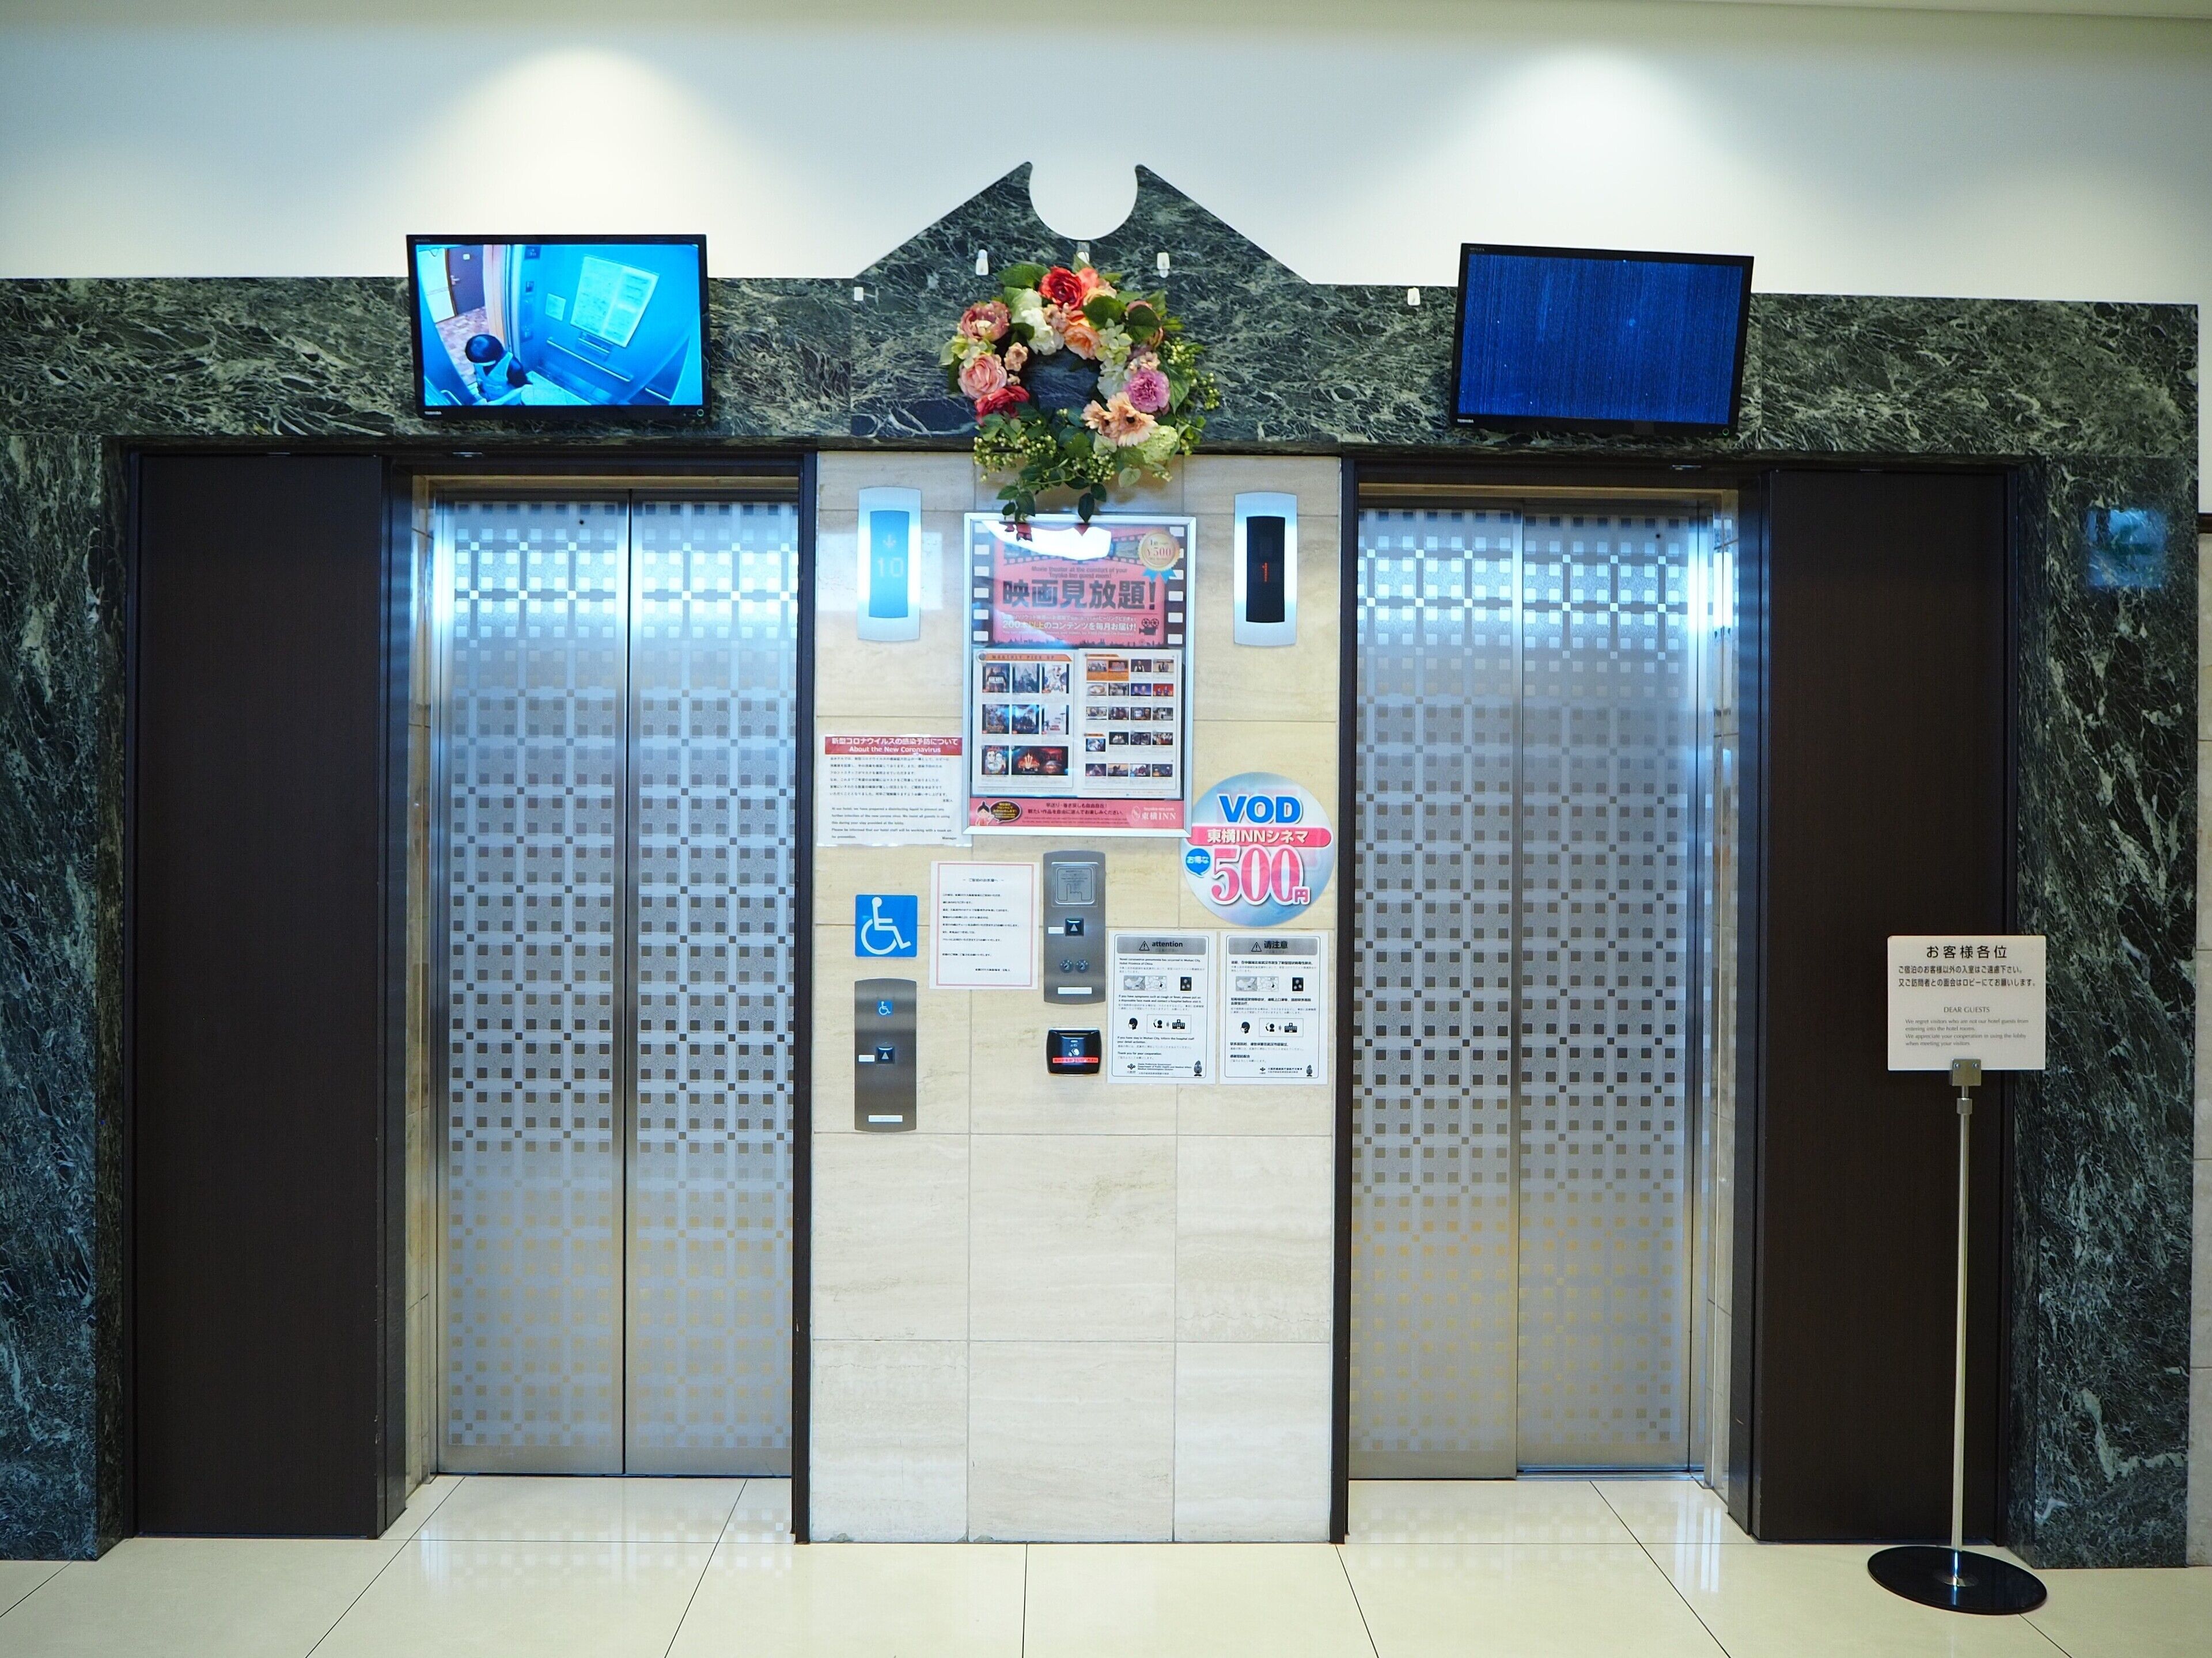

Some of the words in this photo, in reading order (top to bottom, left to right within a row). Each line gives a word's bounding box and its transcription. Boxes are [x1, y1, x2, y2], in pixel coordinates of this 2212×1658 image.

[877, 557, 904, 578] 10
[1262, 561, 1268, 582] 1
[1218, 795, 1301, 824] VOD
[1207, 829, 1308, 843] 東横INNシネマ
[1264, 940, 1288, 949] 请注意
[1926, 945, 2007, 959] お客様各位
[1898, 965, 2023, 974] ご宿泊のお客様以外の入室はご遠慮下さい。
[1898, 978, 2036, 987] 又ご訪問者との面会はロビーにてお願いします。
